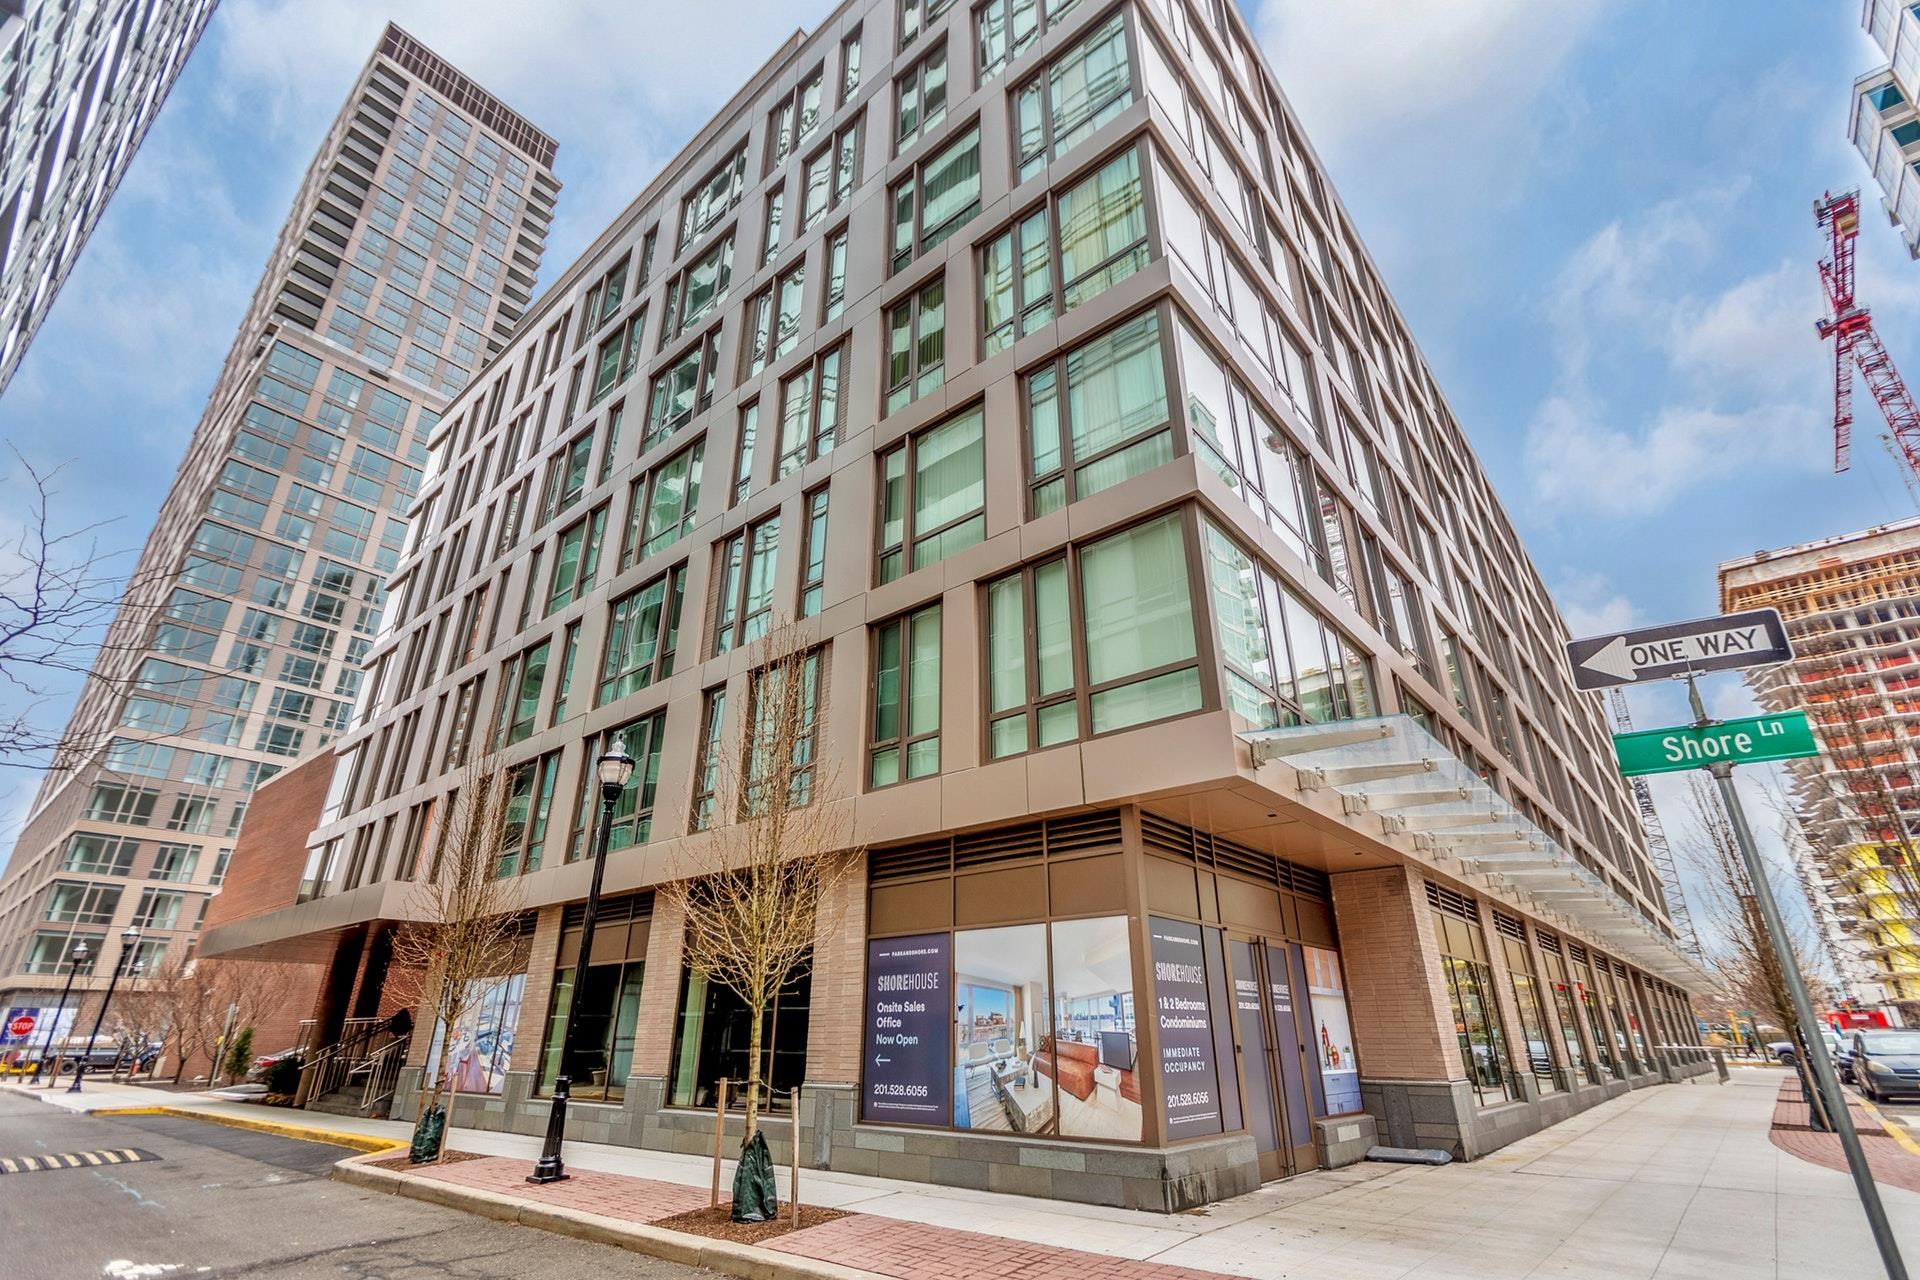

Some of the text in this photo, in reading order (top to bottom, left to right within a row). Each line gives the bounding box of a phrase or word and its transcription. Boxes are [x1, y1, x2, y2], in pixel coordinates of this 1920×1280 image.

[1630, 628, 1757, 666] ONE WAY
[1662, 720, 1784, 762] Shore Ln
[1155, 961, 1203, 985] SHOREHOUSE
[877, 972, 939, 992] SHOREHOUSE
[876, 1001, 926, 1013] Onsite Sales
[1158, 996, 1206, 1011] 1 & 2 Bedrooms
[12, 1021, 34, 1031] STOP
[876, 1016, 902, 1028] Office
[1160, 1015, 1207, 1029] Condominiums
[876, 1033, 919, 1048] Now Open
[1162, 1046, 1200, 1058] IMMEDIATE
[1164, 1060, 1206, 1073] OCCUPANCY
[873, 1084, 928, 1097] 201.528.6056
[1167, 1091, 1209, 1108] 201.528.6056
